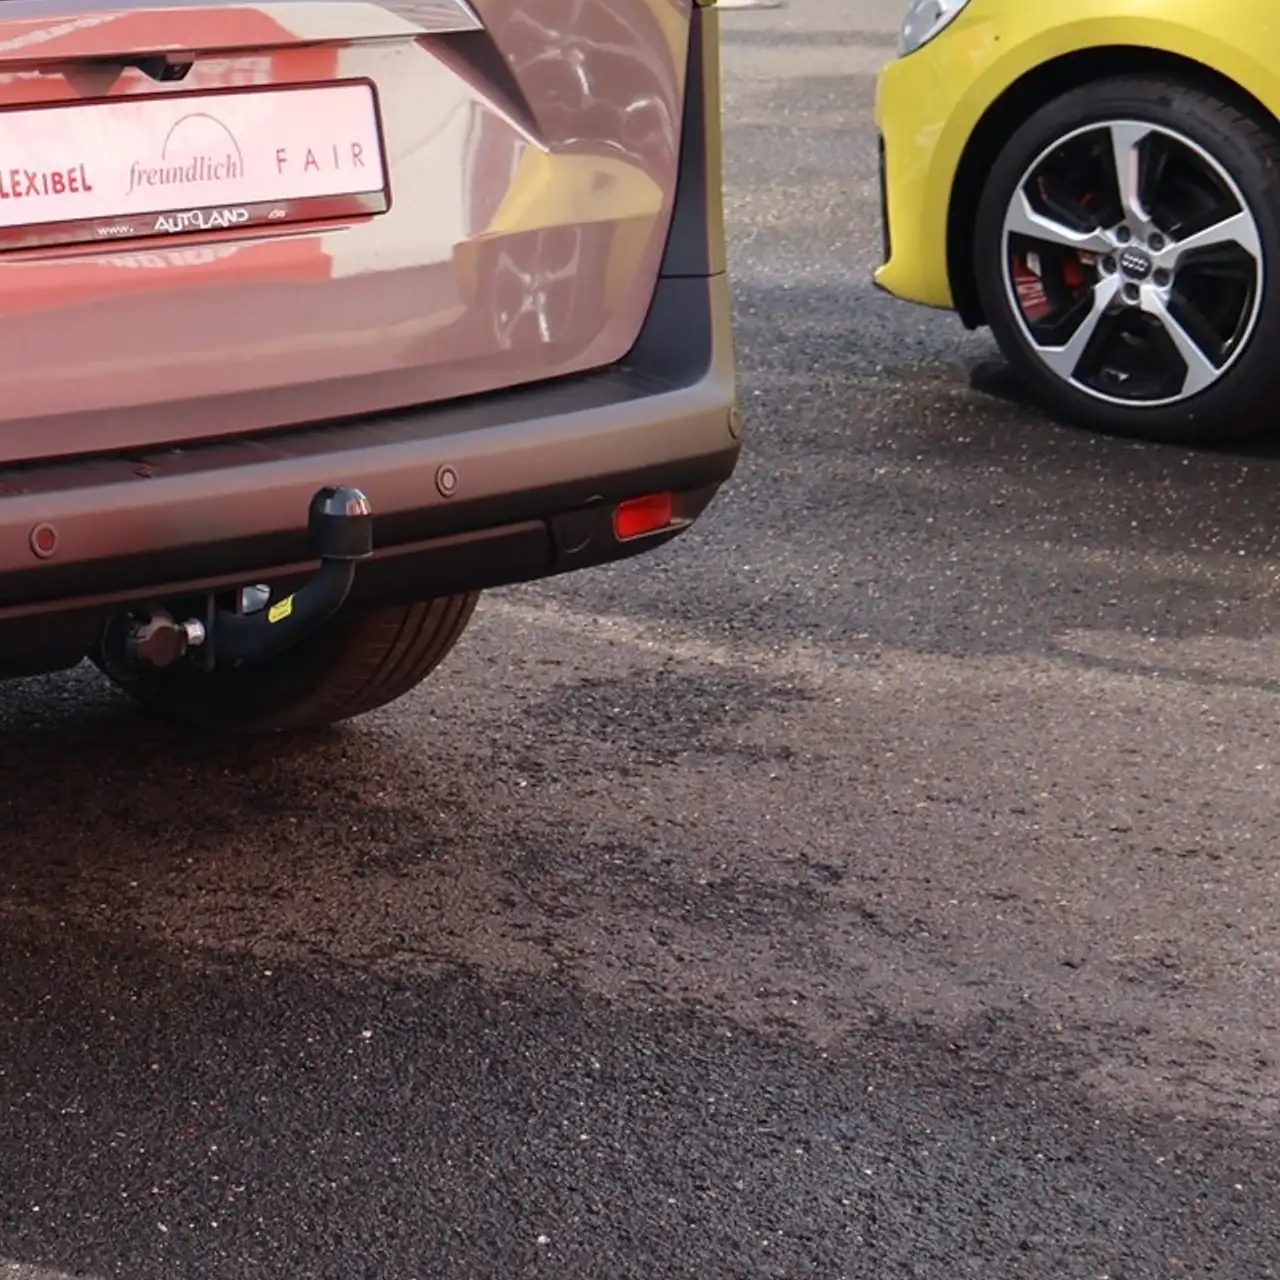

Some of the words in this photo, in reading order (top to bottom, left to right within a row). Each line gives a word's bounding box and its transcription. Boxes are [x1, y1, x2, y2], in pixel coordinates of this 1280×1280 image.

[126, 154, 240, 195] freundlich
[275, 141, 367, 174] FAIR
[154, 207, 250, 234] AUTOLAND
